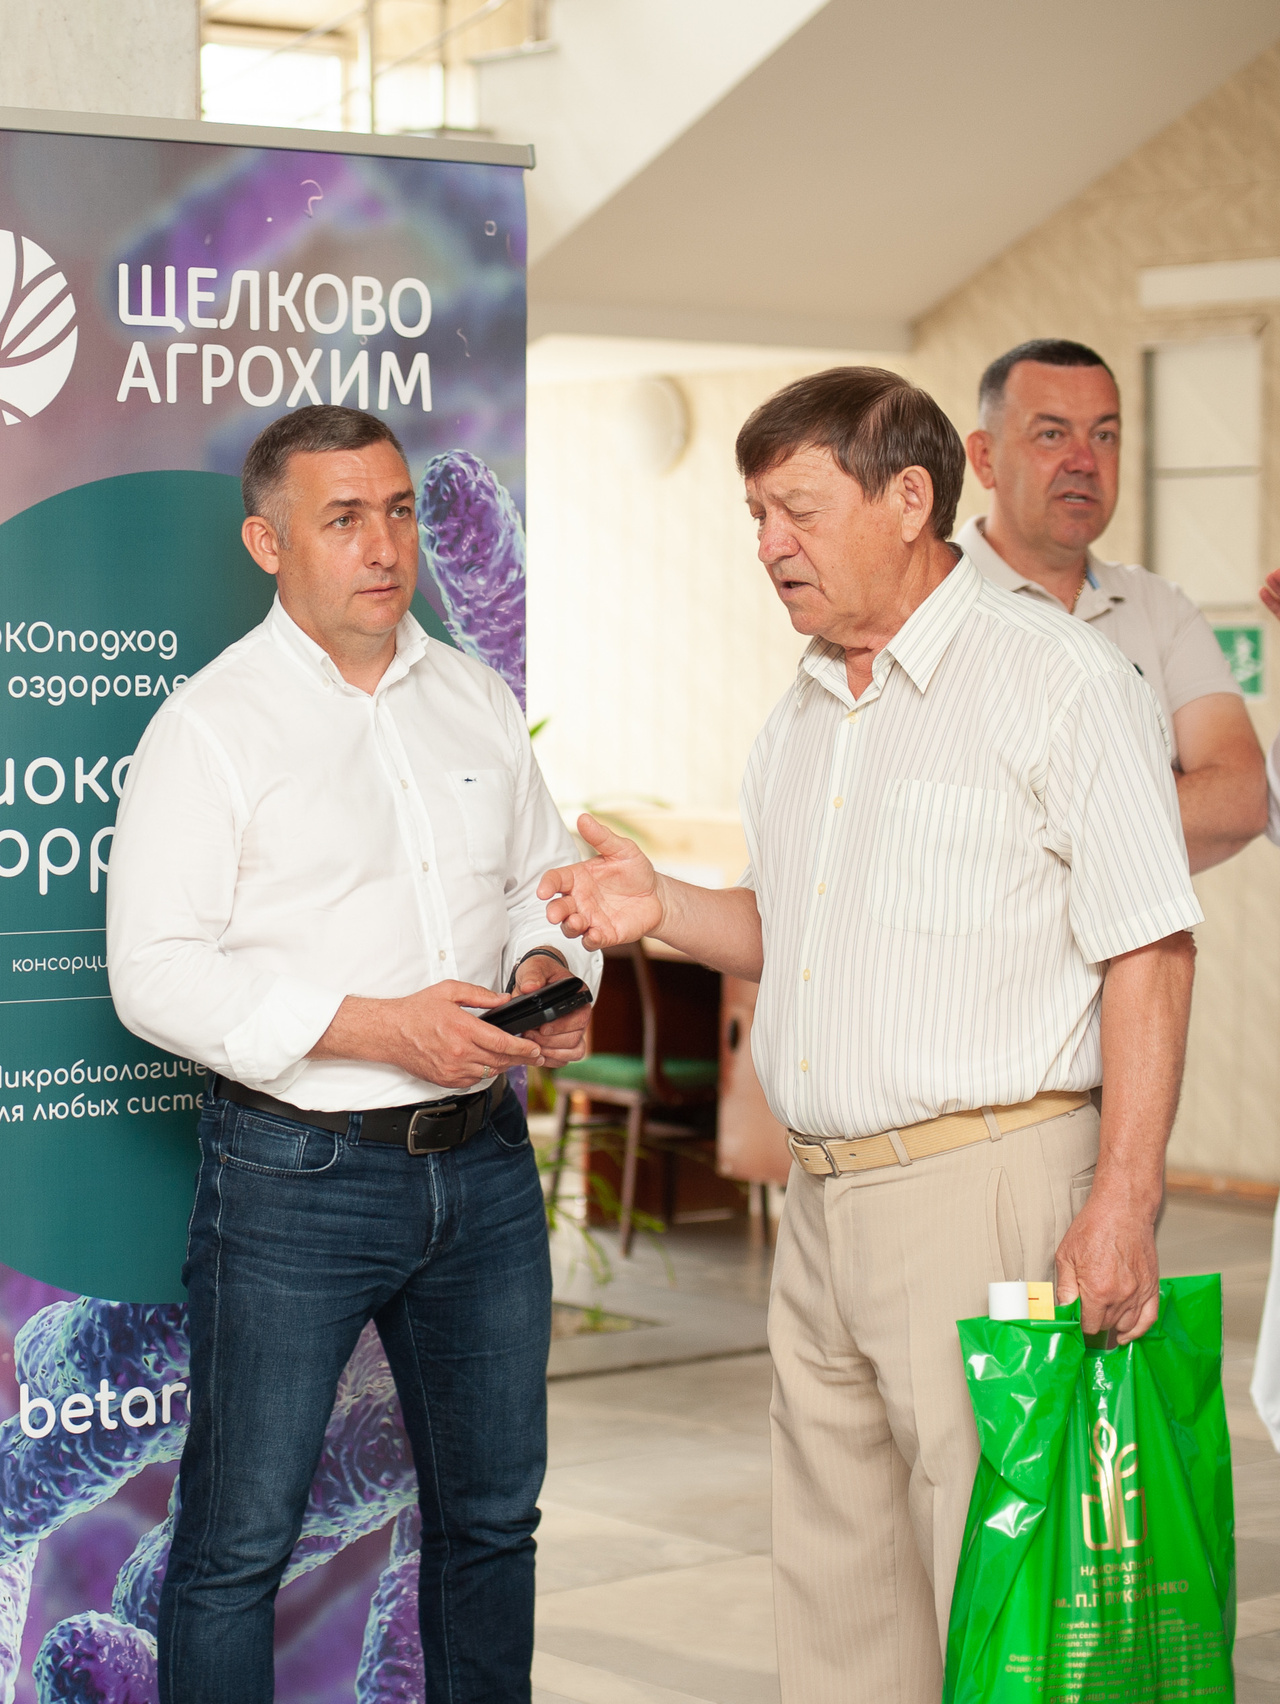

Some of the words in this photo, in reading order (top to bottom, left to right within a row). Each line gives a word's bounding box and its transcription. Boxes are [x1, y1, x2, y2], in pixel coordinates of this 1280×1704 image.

[118, 263, 433, 339] ЩЕЛКОВО
[116, 340, 433, 412] АГРОХИМ
[8, 674, 189, 706] оздоровле
[12, 955, 108, 975] консорци
[33, 1093, 119, 1121] любых
[127, 1092, 204, 1115] систе
[20, 1378, 191, 1439] betar
